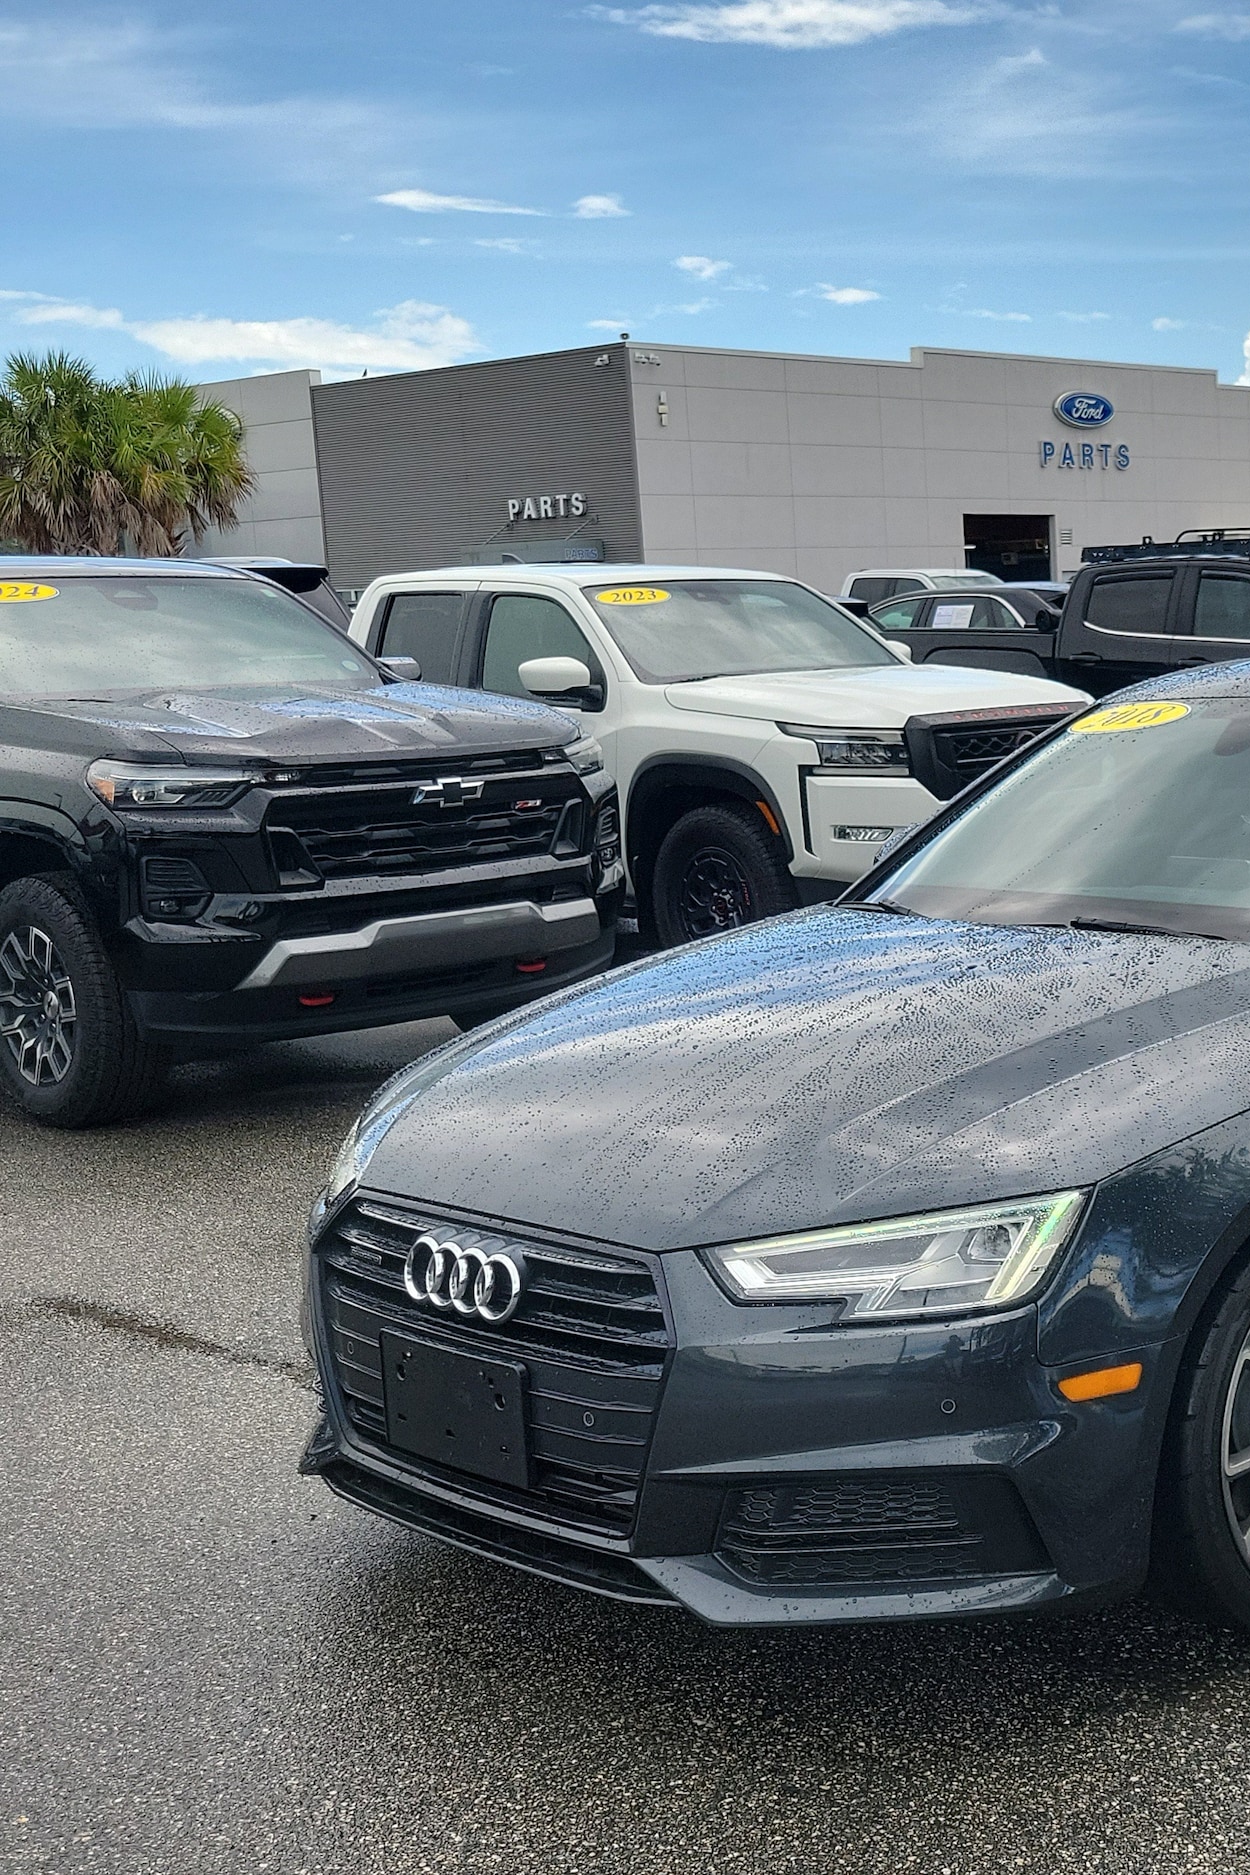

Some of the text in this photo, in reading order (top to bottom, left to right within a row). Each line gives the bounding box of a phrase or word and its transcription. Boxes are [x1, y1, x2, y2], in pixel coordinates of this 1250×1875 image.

[1072, 398, 1105, 420] Ford
[1041, 441, 1130, 470] PARTS
[508, 493, 586, 520] PARTS
[565, 548, 598, 560] PARTS
[610, 590, 657, 603] 2023
